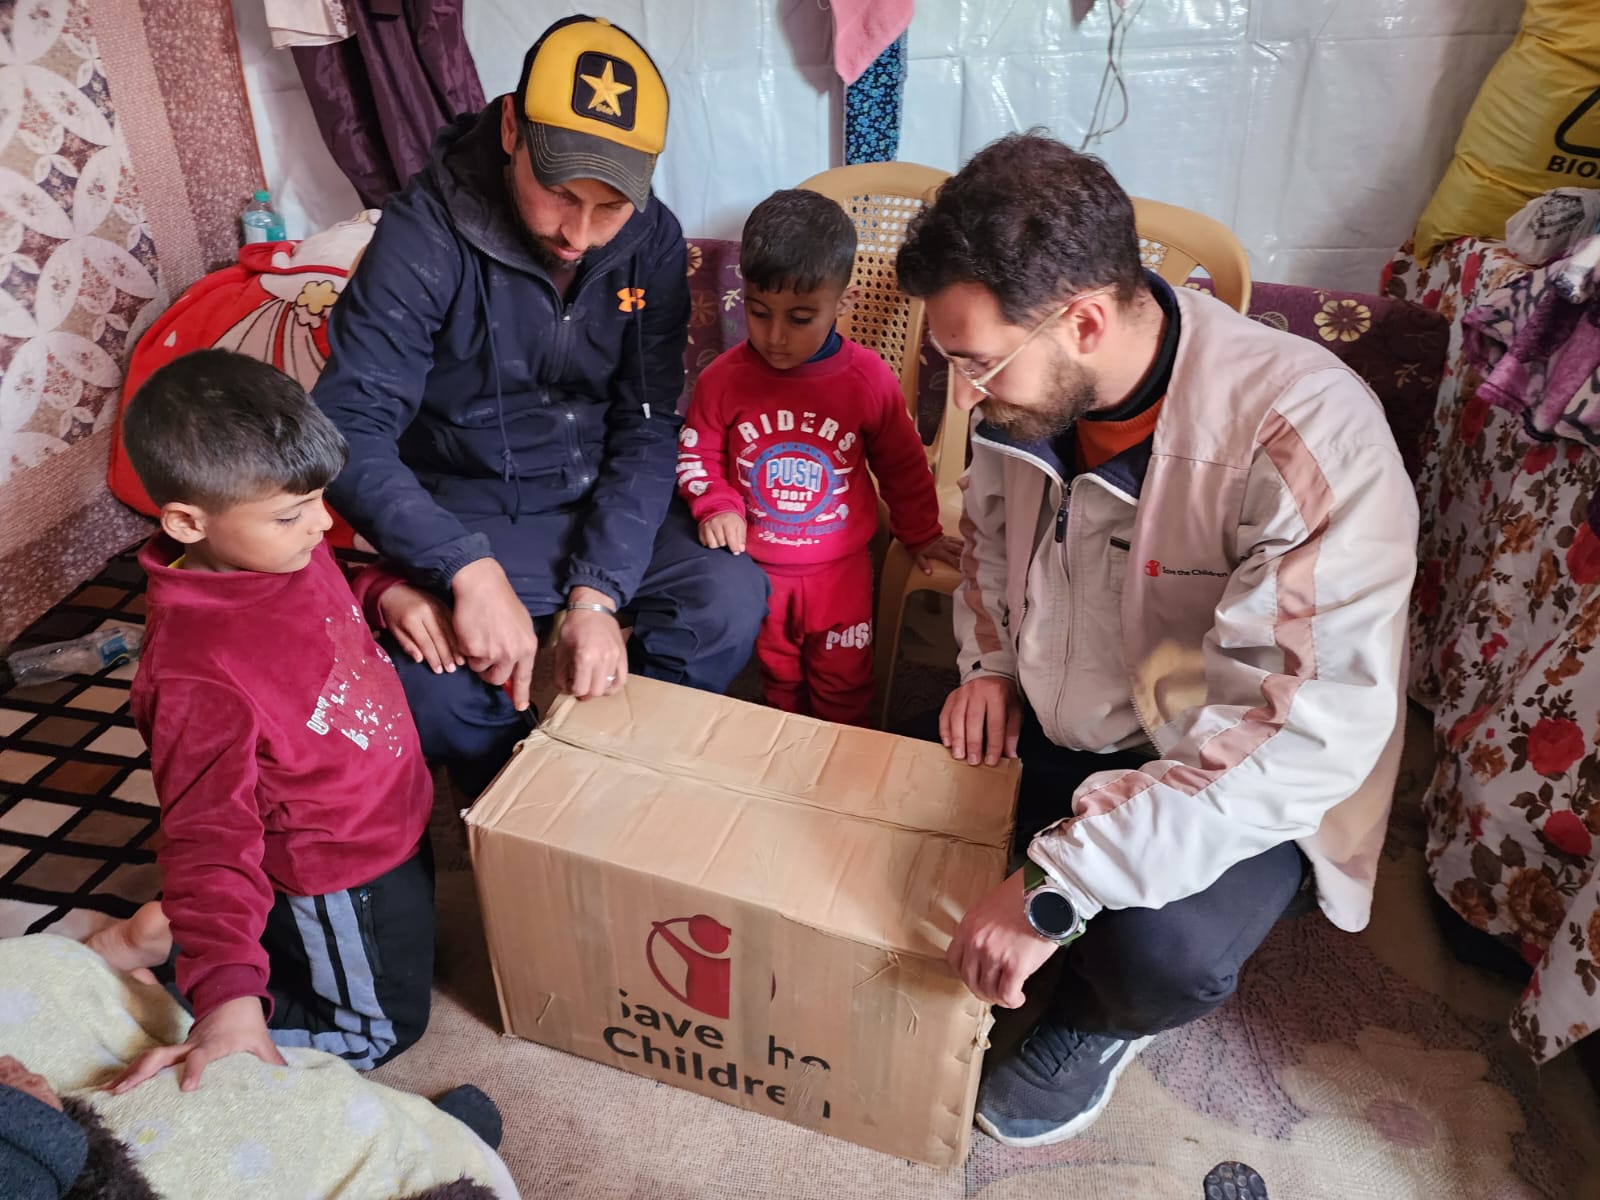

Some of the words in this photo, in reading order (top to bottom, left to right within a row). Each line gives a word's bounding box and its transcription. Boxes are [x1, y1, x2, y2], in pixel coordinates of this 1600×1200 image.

[1546, 154, 1600, 180] BIO
[737, 410, 857, 452] RIDERS
[766, 457, 823, 492] PUSH
[771, 488, 813, 502] sport
[603, 1026, 831, 1119] Childre
